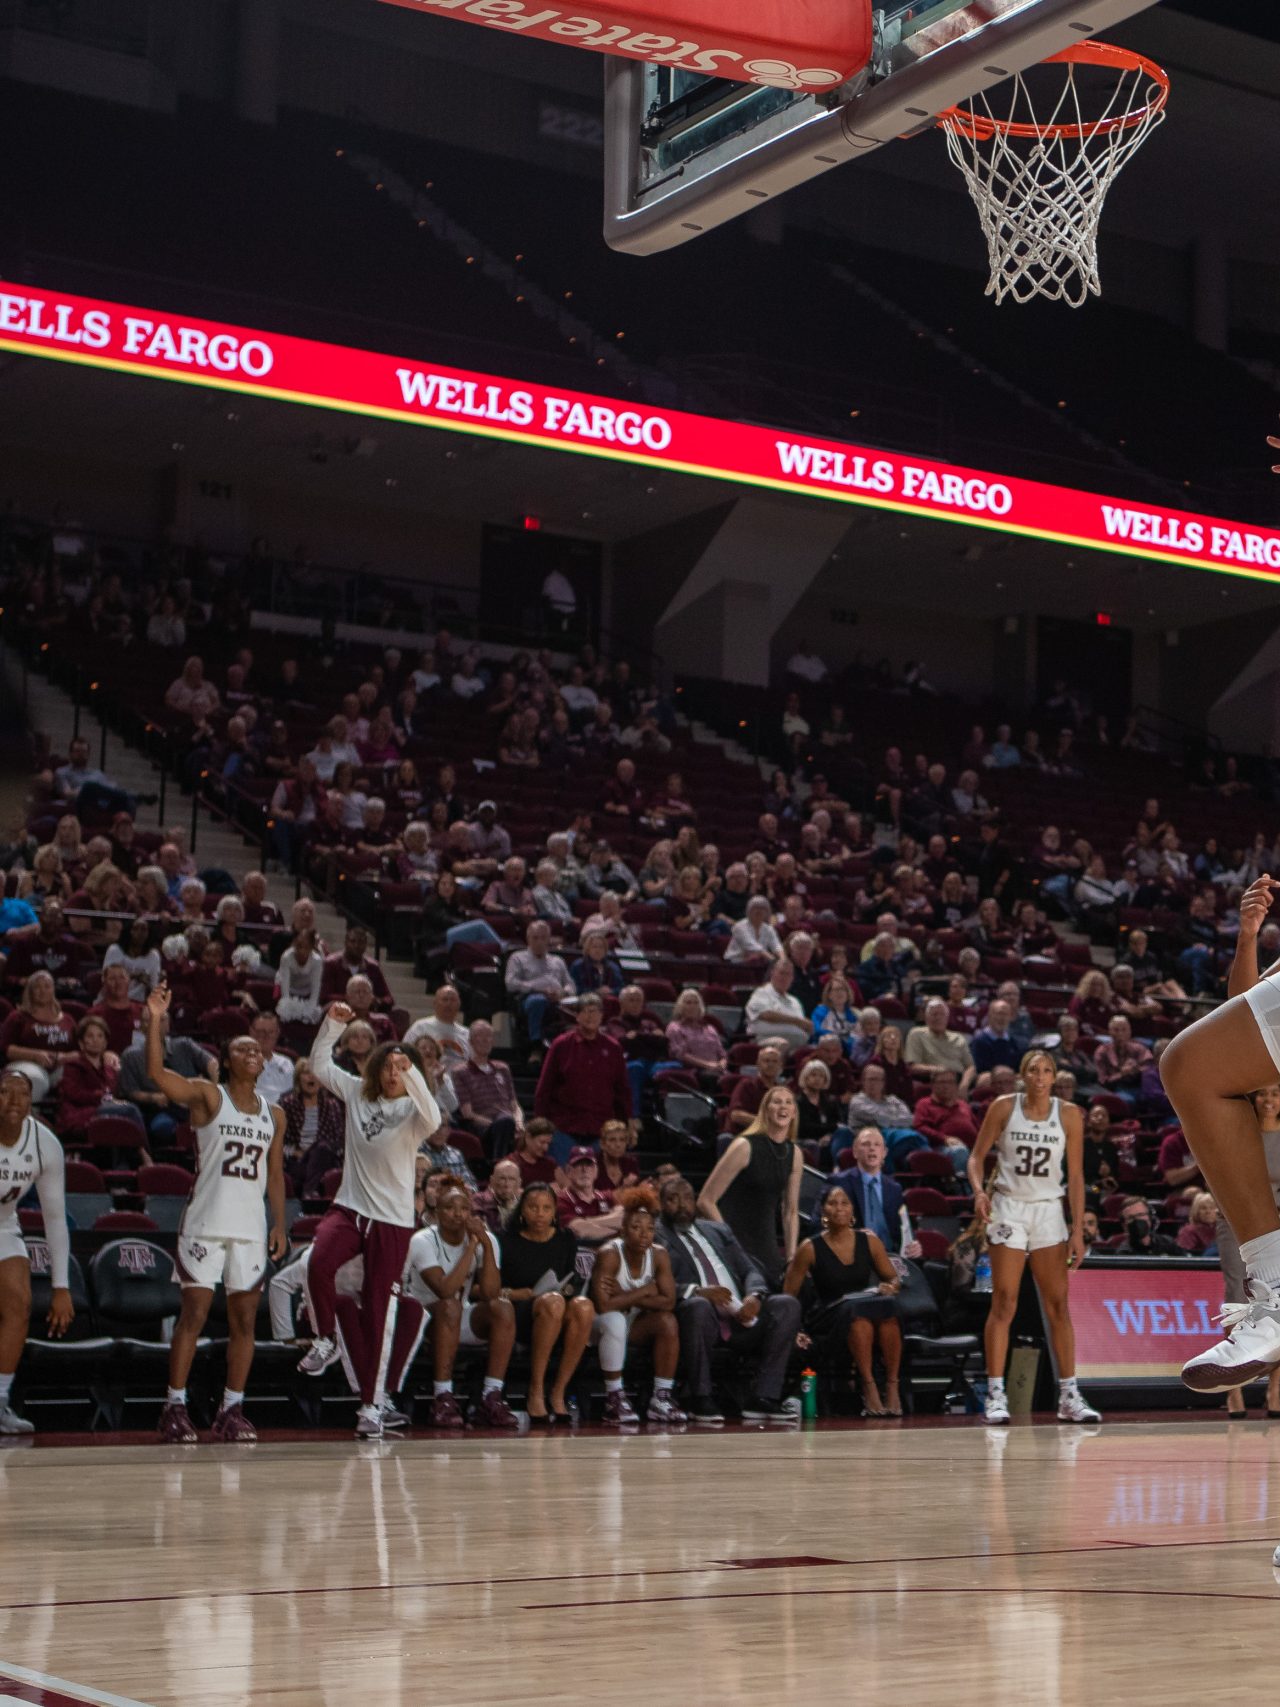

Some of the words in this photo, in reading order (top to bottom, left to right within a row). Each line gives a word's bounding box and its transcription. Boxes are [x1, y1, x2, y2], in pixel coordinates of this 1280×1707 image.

[0, 292, 112, 348] ELLS
[122, 317, 274, 377] FARGO
[396, 368, 534, 426] WELLS
[543, 396, 672, 450] FARGO
[775, 441, 895, 493] WELLS
[901, 466, 1013, 515] FARGO
[1101, 505, 1203, 553] WELLS
[219, 1125, 253, 1138] TEXAS
[1010, 1131, 1040, 1143] TEXAS
[221, 1140, 263, 1181] 23
[1014, 1145, 1051, 1177] 32
[1104, 1299, 1224, 1335] WELL
